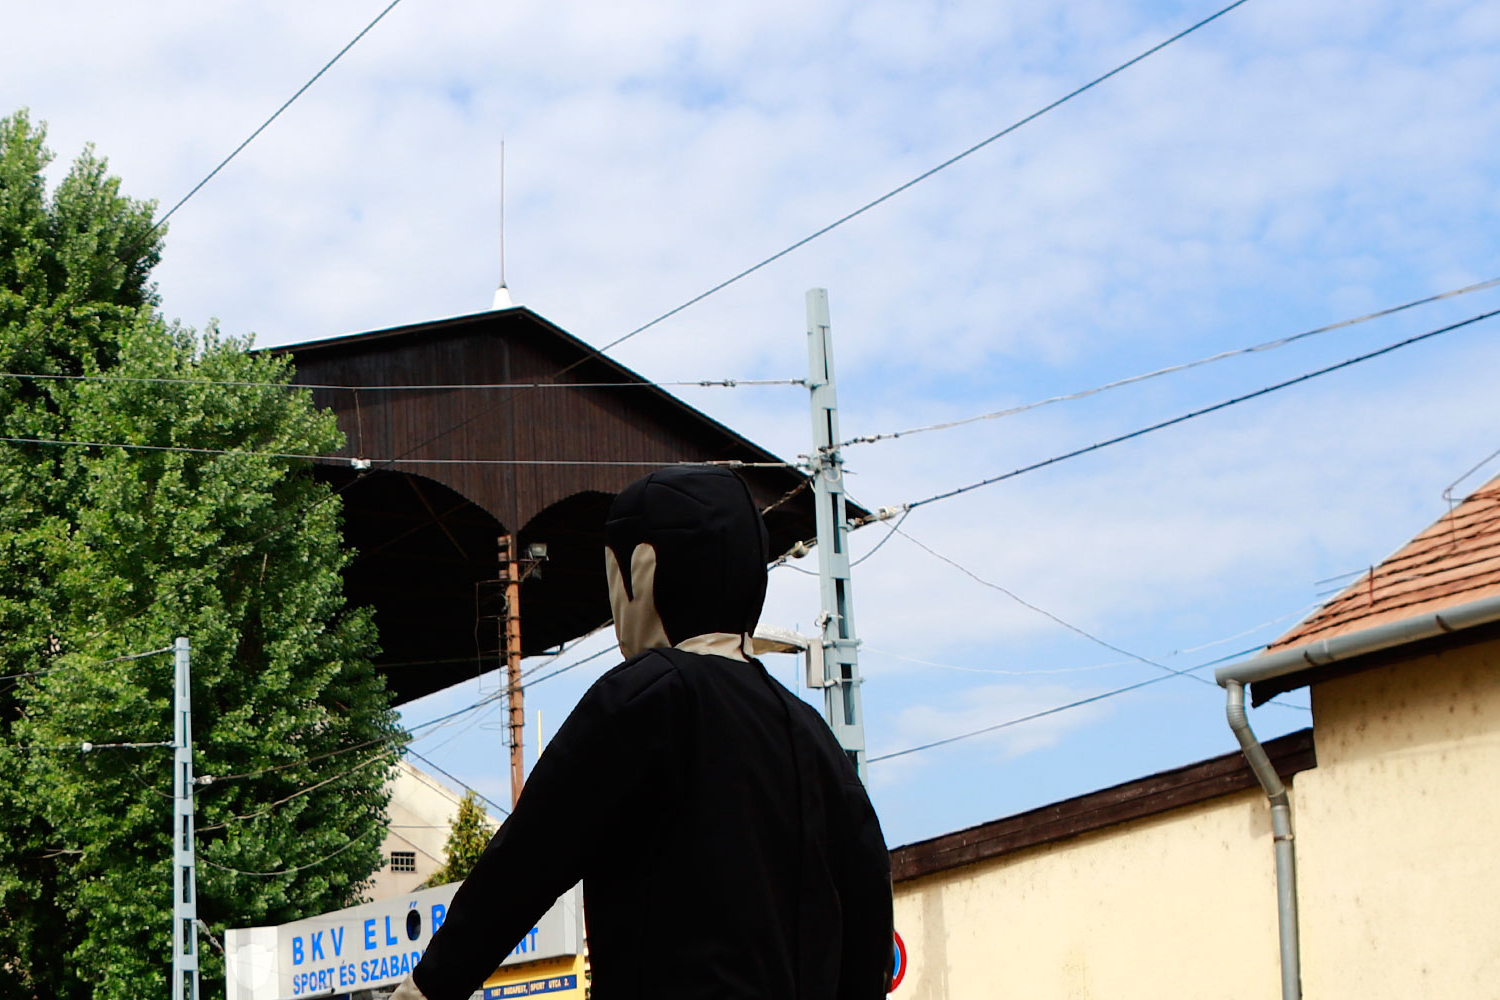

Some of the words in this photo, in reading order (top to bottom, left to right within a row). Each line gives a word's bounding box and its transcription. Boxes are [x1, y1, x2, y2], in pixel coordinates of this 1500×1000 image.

[292, 926, 344, 966] BKV
[363, 901, 447, 951] ELŐR
[293, 967, 336, 995] SPORT
[339, 960, 357, 987] ÉS
